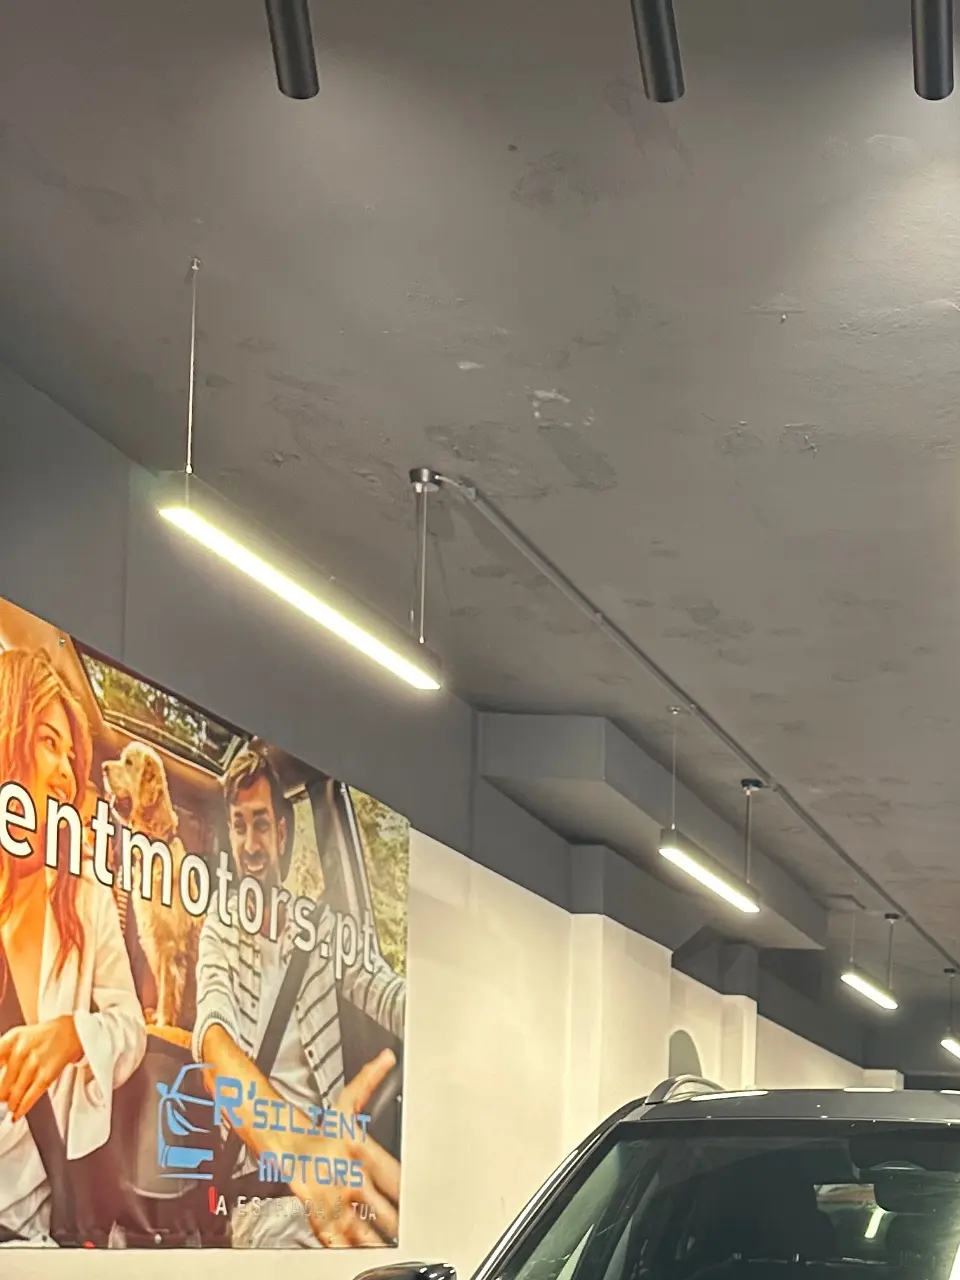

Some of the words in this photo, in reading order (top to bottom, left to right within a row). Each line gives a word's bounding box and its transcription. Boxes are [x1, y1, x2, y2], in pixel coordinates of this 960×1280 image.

[0, 781, 379, 980] entmotors.pt
[257, 1151, 364, 1188] MOTORS
[215, 1195, 228, 1216] A
[351, 1202, 377, 1221] TUA
